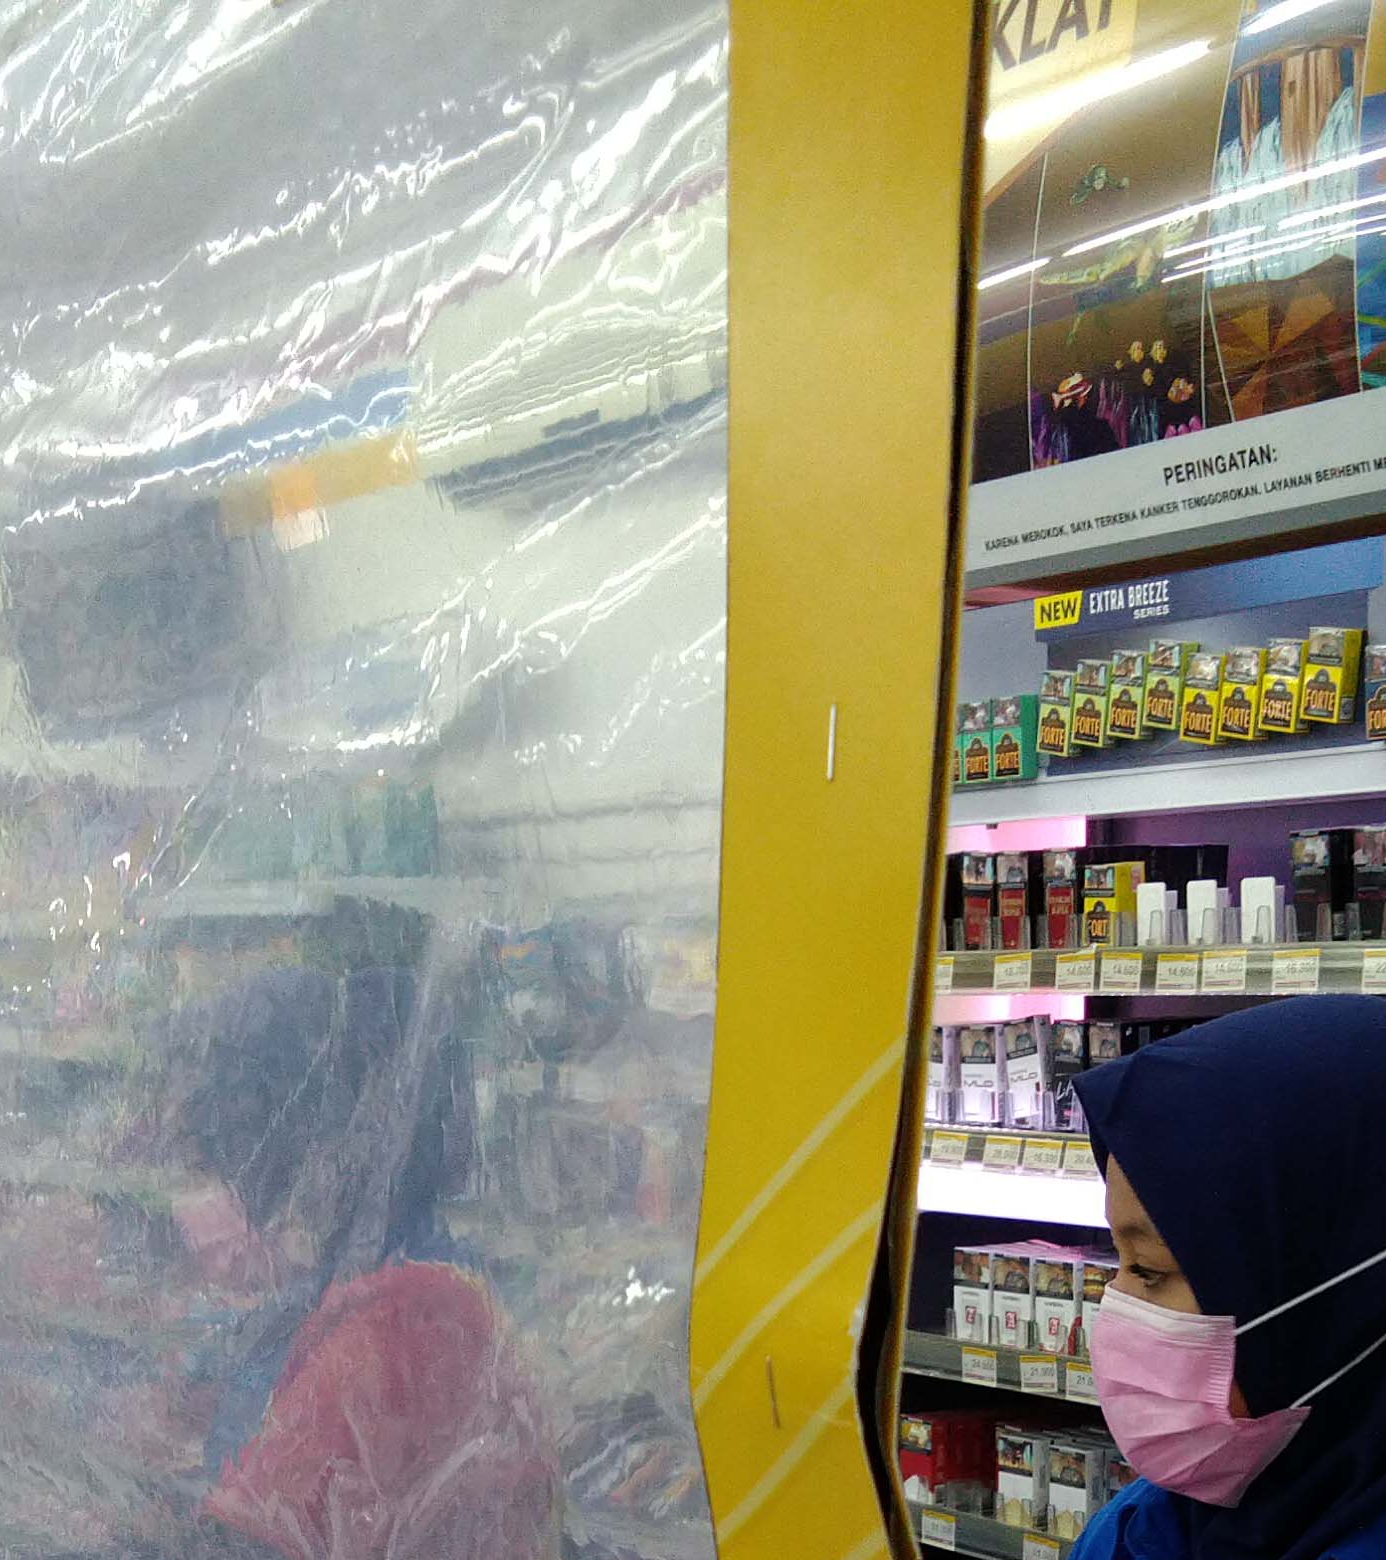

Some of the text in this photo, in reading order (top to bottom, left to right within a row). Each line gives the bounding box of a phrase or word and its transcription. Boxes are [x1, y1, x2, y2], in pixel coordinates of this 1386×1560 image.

[1162, 443, 1278, 487] PERINGATAN:
[984, 533, 1021, 553] KARENA
[1069, 518, 1094, 534] SAYA
[1094, 509, 1139, 530] TERKENA
[1139, 500, 1180, 521] KANKER
[1262, 473, 1313, 497] LAYANAN
[1314, 460, 1372, 485] BERHENTI
[1039, 579, 1170, 624] NEW EXTRA BREEZE
[1132, 603, 1171, 620] SERIES
